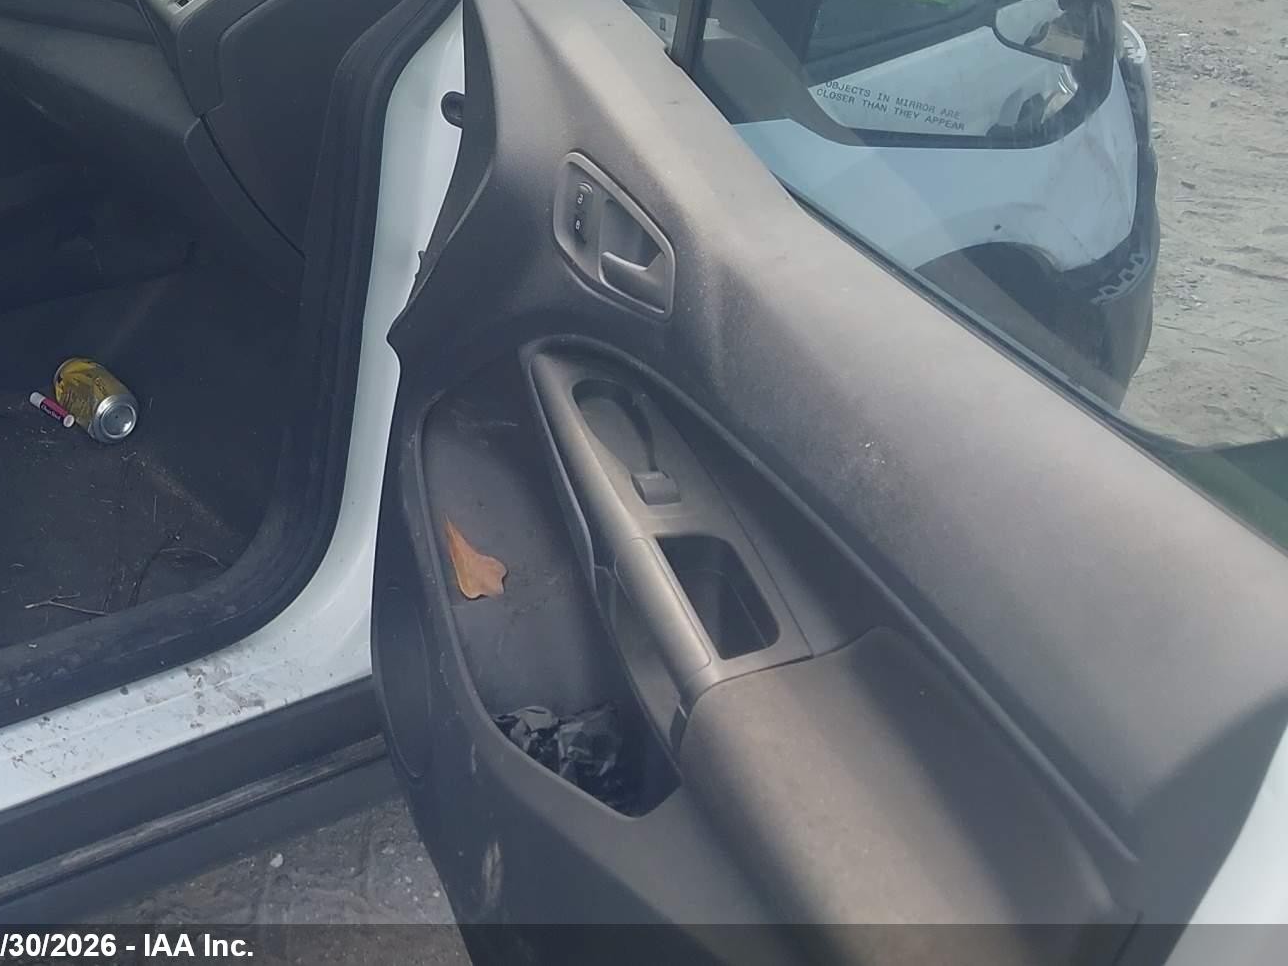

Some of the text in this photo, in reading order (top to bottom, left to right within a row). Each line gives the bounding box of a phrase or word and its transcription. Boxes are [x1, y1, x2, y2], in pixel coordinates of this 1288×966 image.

[816, 88, 965, 130] CLOSER THAN THEY APPEAR
[825, 80, 961, 120] OBJECTS IN MIRROR ARE
